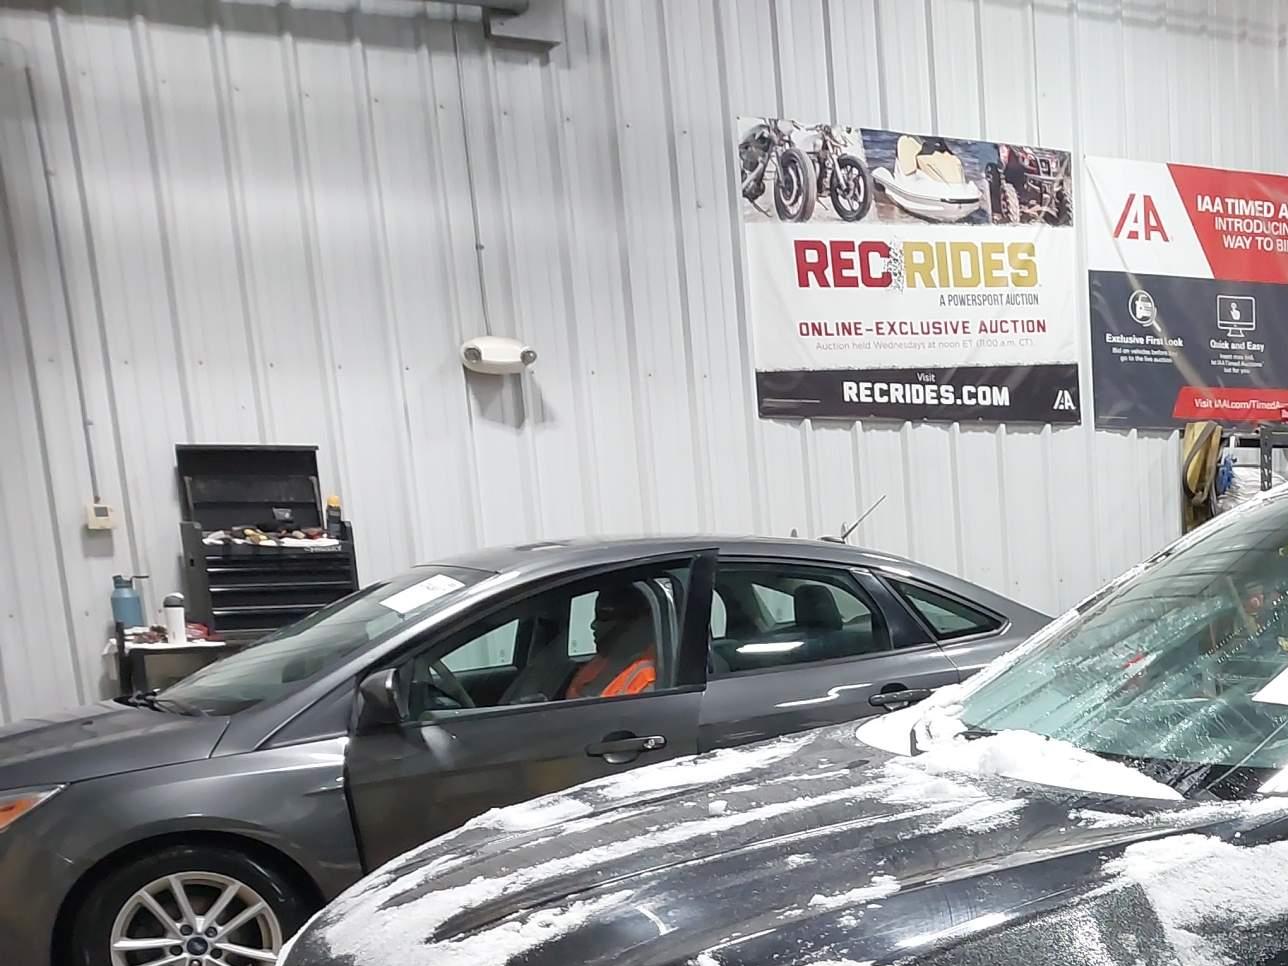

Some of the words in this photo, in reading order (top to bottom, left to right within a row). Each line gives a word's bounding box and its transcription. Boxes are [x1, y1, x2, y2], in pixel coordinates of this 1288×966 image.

[1197, 195, 1223, 213] IAA
[1225, 199, 1275, 218] TIMED
[1223, 234, 1252, 249] WAY
[1255, 237, 1274, 250] TO
[939, 294, 946, 307] A
[948, 294, 1004, 306] POWERSPORT
[1005, 293, 1039, 305] AUCTION
[799, 320, 971, 336] ONLINE-EXCLUSIVE
[978, 319, 1046, 334] AUCTION
[816, 342, 850, 351] Auction
[852, 341, 871, 350] held
[873, 341, 926, 351] Wednesdays
[927, 340, 936, 349] at
[1105, 333, 1145, 345] Exclusive
[1210, 339, 1230, 350] Quick
[1231, 341, 1246, 351] and
[1246, 341, 1265, 353] Easy
[916, 372, 936, 383] Visit
[842, 381, 1010, 407] RECRIDES.COM
[1194, 398, 1213, 409] Visit
